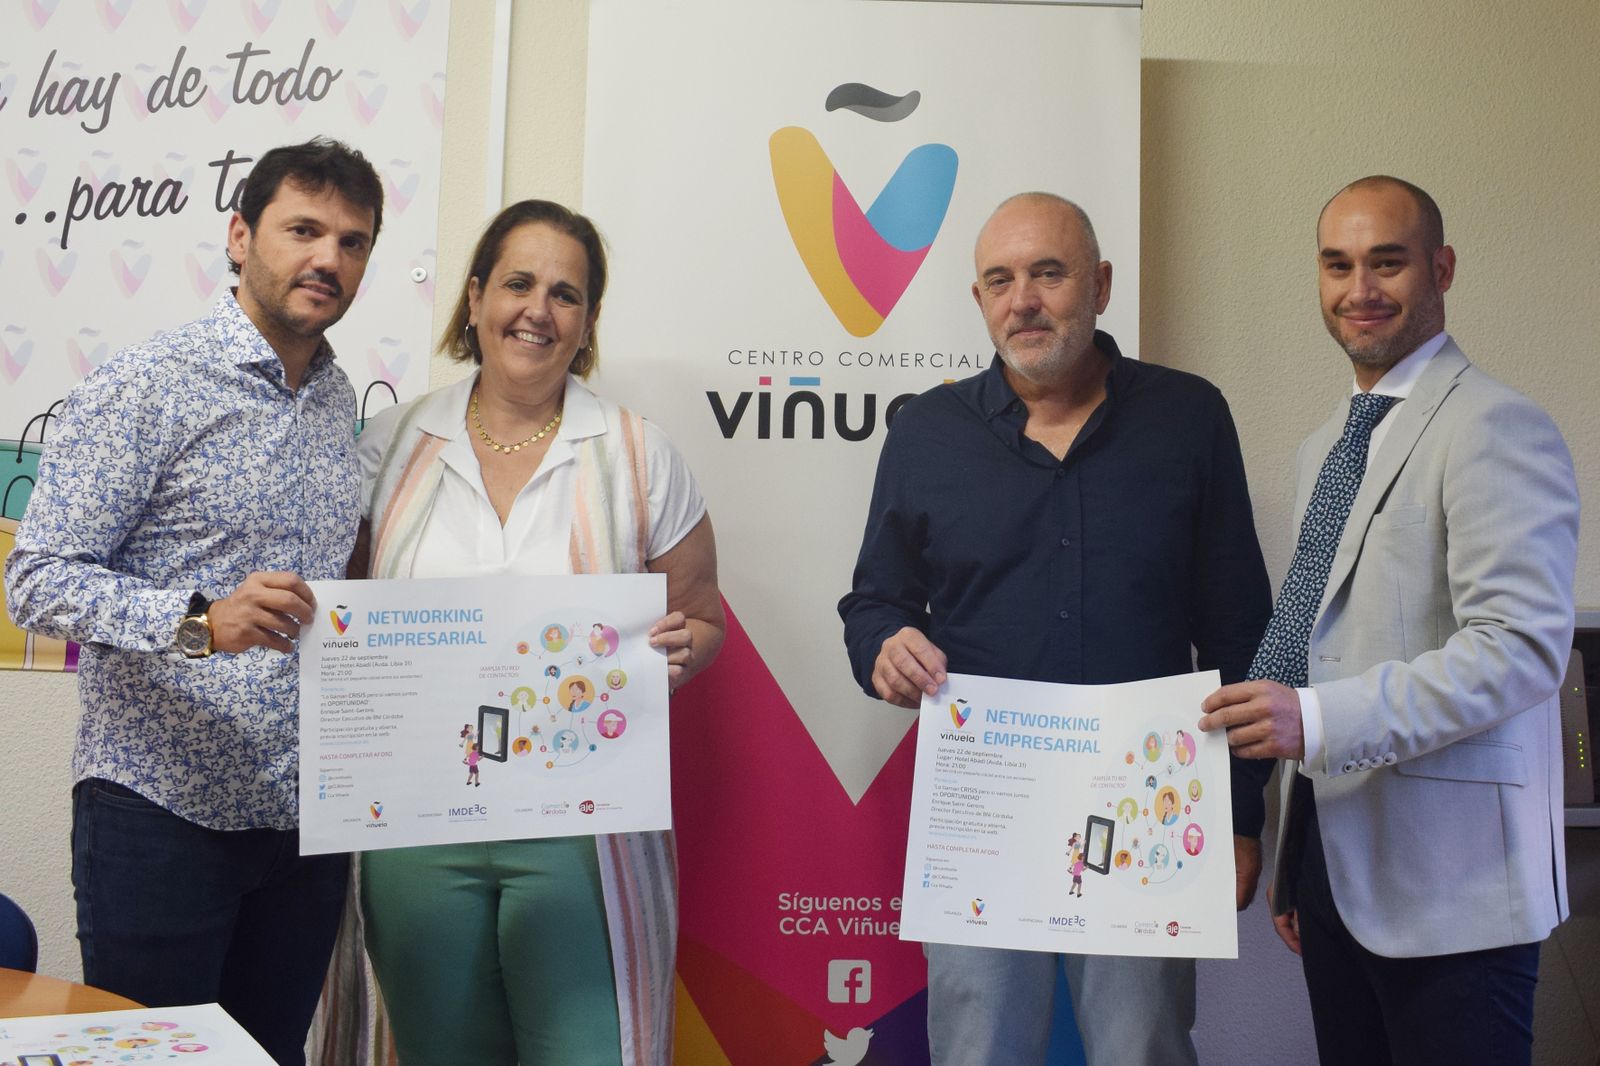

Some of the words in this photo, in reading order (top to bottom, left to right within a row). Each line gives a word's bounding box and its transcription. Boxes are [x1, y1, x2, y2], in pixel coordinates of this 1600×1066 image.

[28, 49, 121, 134] hay
[147, 45, 208, 114] de
[226, 38, 343, 106] todo
[728, 350, 824, 366] CENTRO
[838, 351, 984, 369] COMERCIAL
[367, 608, 484, 625] NETWORKING
[367, 630, 487, 648] EMPRESARIAL
[985, 708, 1100, 732] NETWORKING
[983, 731, 1102, 754] EMPRESARIAL
[972, 751, 1003, 759] septiembre
[946, 845, 980, 854] COMPLETAR
[778, 892, 882, 914] Síguenos
[779, 917, 830, 935] CCA
